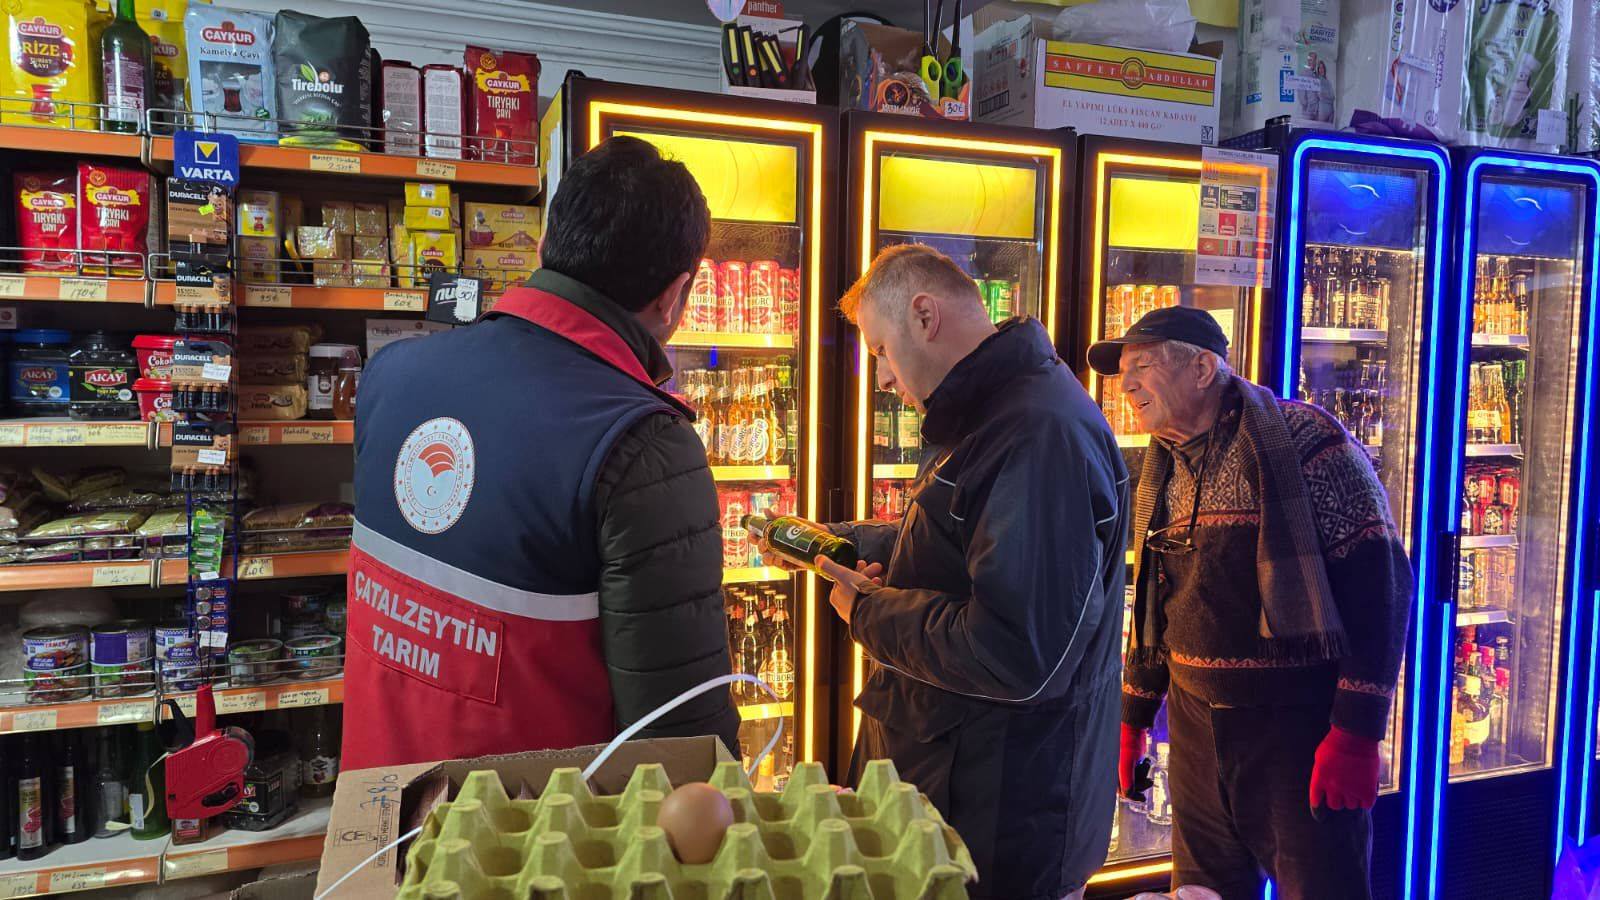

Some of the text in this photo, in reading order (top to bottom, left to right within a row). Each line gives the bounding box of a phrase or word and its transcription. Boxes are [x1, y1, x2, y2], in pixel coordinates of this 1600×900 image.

[748, 0, 777, 14] panther
[22, 39, 60, 57] RİZE
[1052, 60, 1115, 76] SAFFET
[291, 78, 344, 94] Tirebolu
[1149, 73, 1209, 88] ABDULLAH
[181, 166, 235, 181] VARTA
[169, 191, 206, 200] DURACELL
[176, 275, 211, 283] DURACELL
[22, 370, 54, 379] AKAY
[88, 373, 125, 382] AKAY
[355, 570, 497, 657] ÇATALZEYTİN
[372, 624, 440, 679] TARIM
